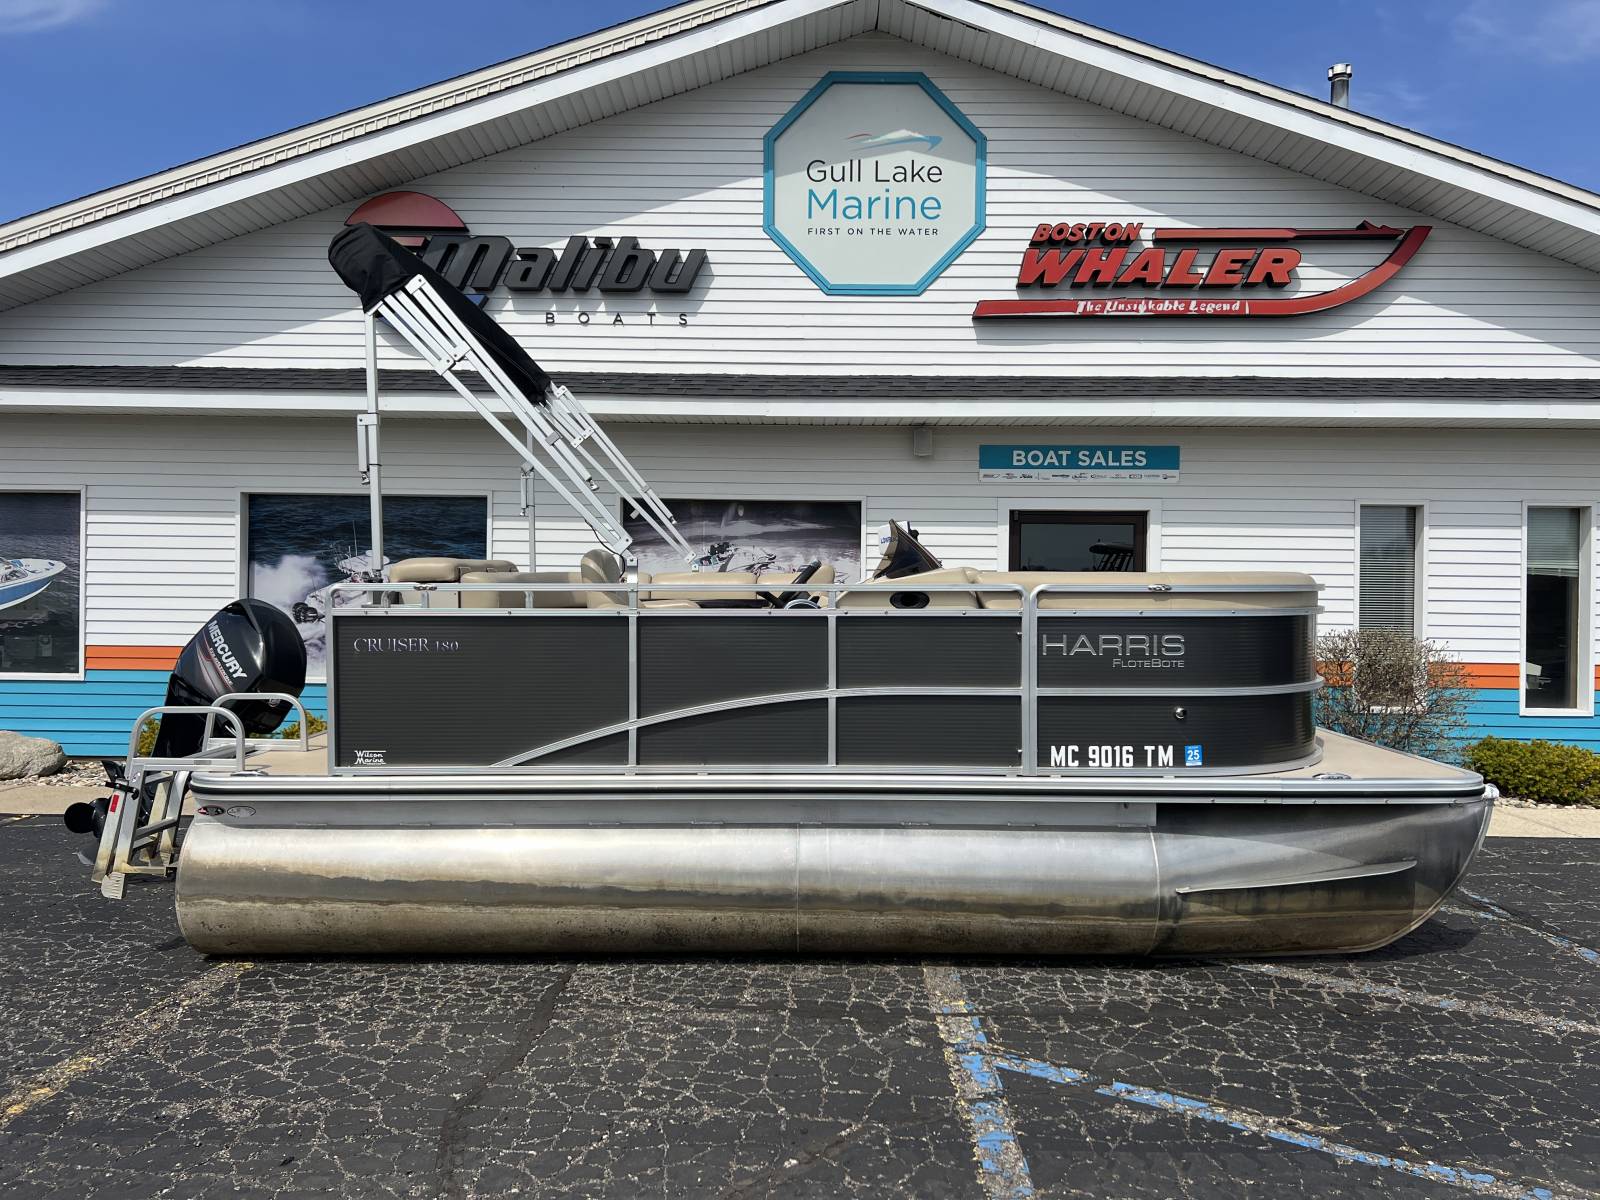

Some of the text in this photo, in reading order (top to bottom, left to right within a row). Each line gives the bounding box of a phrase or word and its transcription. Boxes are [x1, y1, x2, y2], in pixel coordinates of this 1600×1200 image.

[806, 159, 943, 183] Gull Lake
[806, 188, 942, 220] Marine
[807, 227, 939, 236] FIRST ON THE WATER
[1029, 222, 1144, 247] BOSTON
[1016, 246, 1301, 288] WHALER
[1076, 299, 1102, 314] The
[1189, 299, 1241, 314] Legend
[545, 312, 688, 326] BOATS
[1012, 449, 1148, 467] BOAT SALES
[208, 620, 248, 678] MERCURY
[353, 637, 459, 652] CRUISER 180
[1042, 634, 1186, 656] HARRIS
[354, 750, 385, 758] Wilson
[354, 757, 385, 766] Marine
[1050, 745, 1174, 767] MC 9016 TM
[1187, 749, 1200, 761] 25
